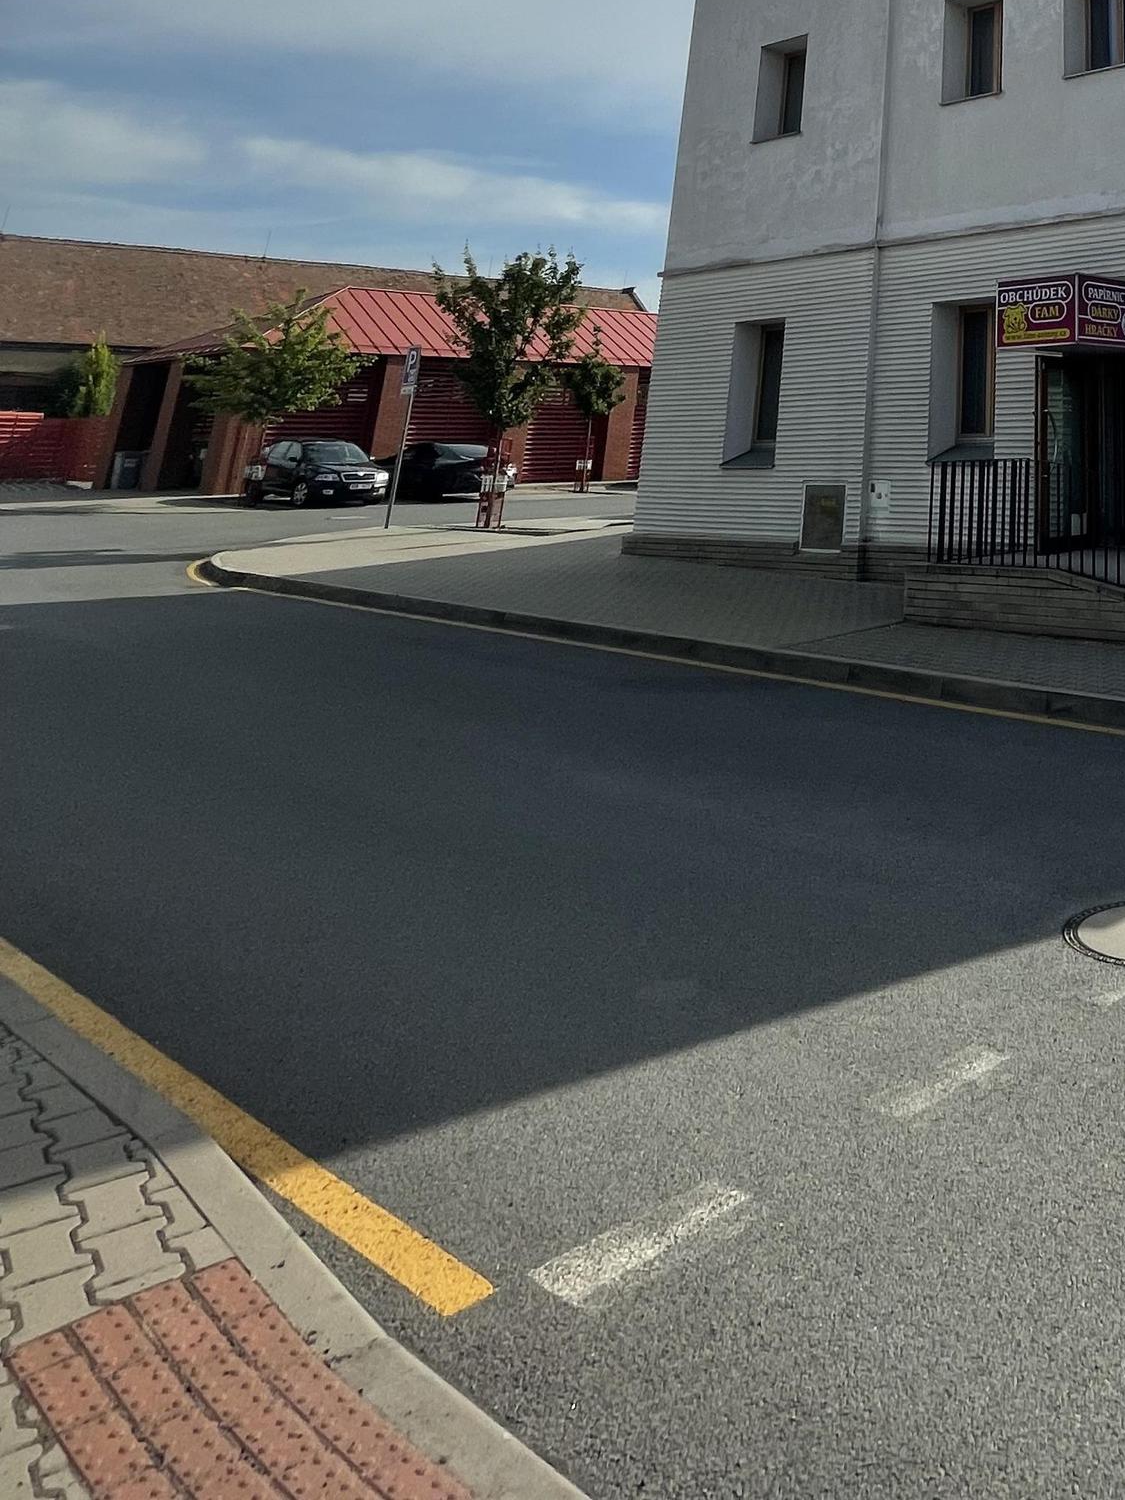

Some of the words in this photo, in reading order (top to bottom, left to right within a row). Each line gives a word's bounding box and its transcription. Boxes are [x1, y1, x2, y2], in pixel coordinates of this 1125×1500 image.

[1000, 285, 1067, 304] OBCHŮDEK
[1035, 305, 1059, 319] FAM
[1091, 304, 1119, 320] DÁRKY
[1085, 323, 1119, 338] HRAČKY
